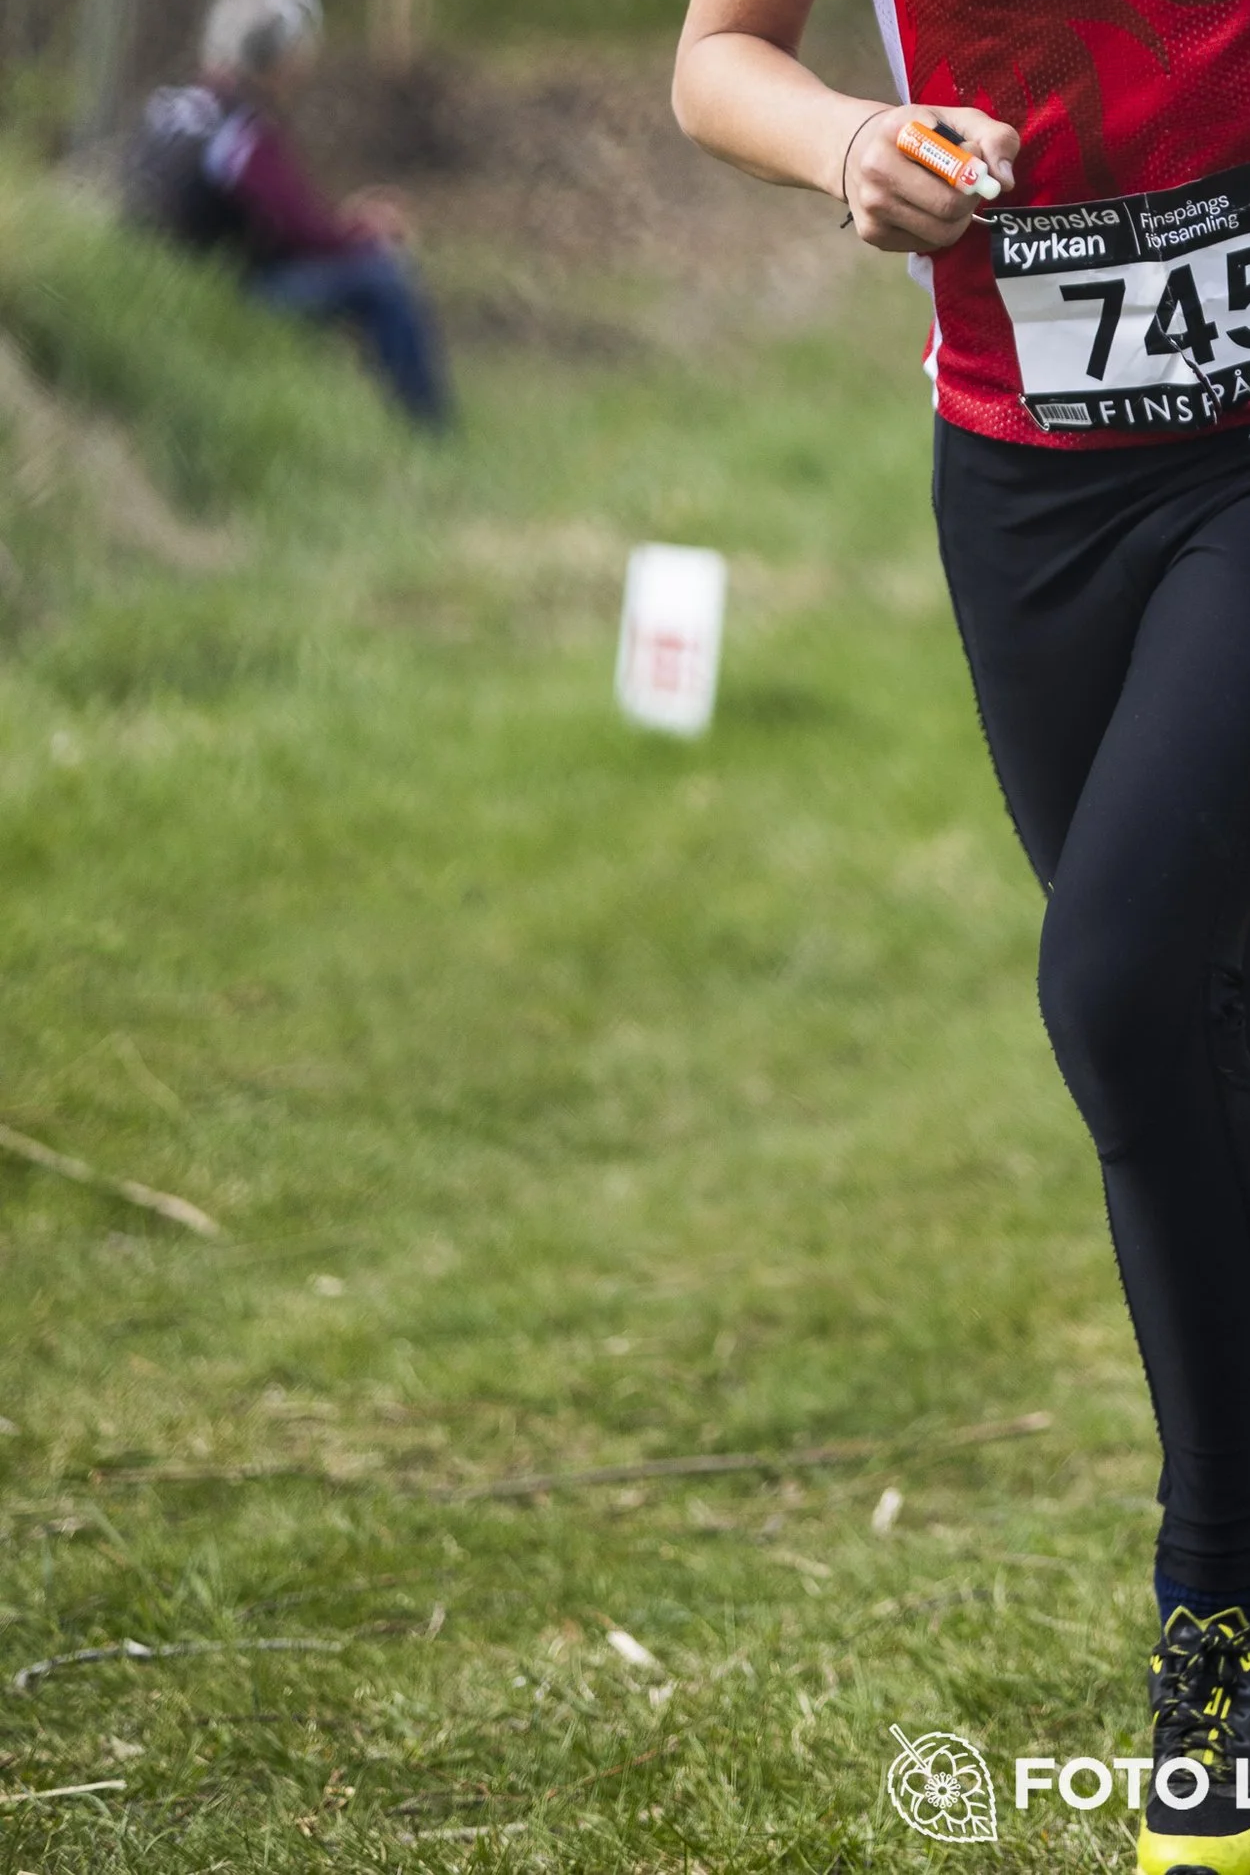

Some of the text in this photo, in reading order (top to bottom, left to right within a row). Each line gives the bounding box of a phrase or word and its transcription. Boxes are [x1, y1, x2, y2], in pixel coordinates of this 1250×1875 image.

[1000, 207, 1121, 236] Svenska
[1139, 194, 1231, 229] Finspångs
[1145, 211, 1240, 249] församling
[1003, 232, 1106, 270] kyrkan
